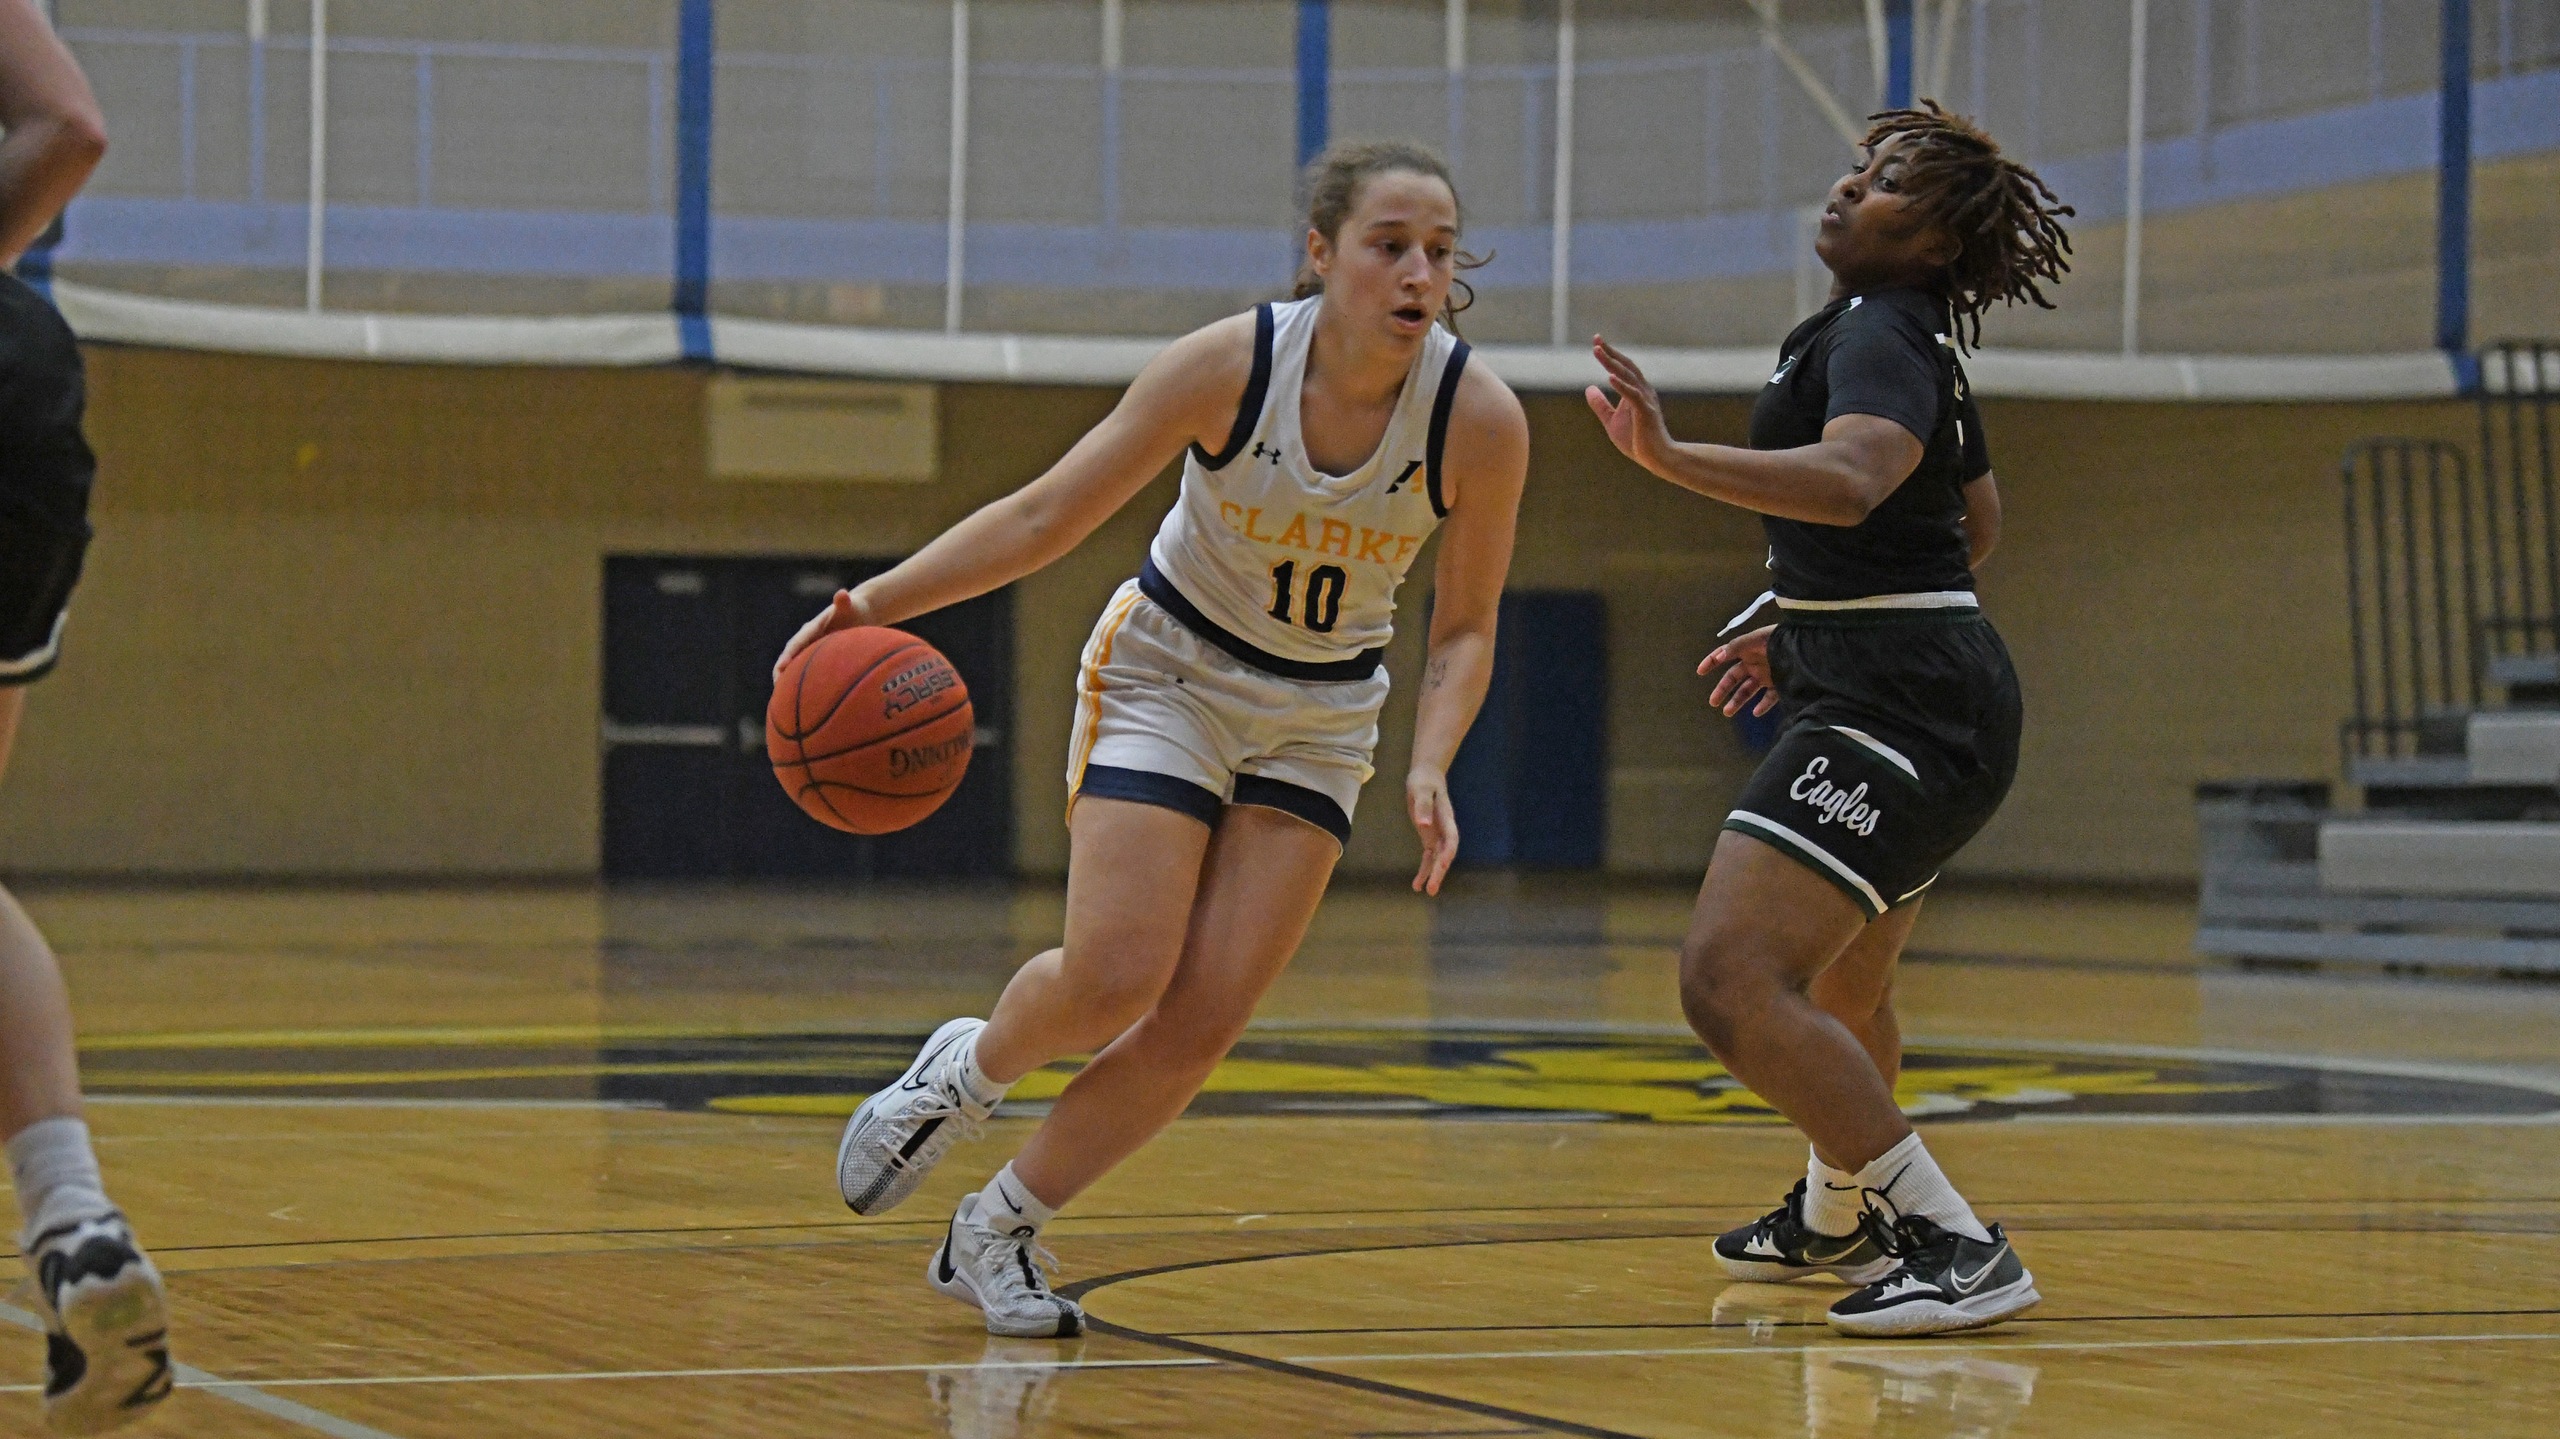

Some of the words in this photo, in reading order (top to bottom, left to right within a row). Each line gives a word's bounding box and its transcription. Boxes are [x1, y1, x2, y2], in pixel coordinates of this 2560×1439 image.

[1220, 501, 1419, 564] CLARKE
[1264, 556, 1350, 633] 10
[1789, 756, 1881, 836] Eagles
